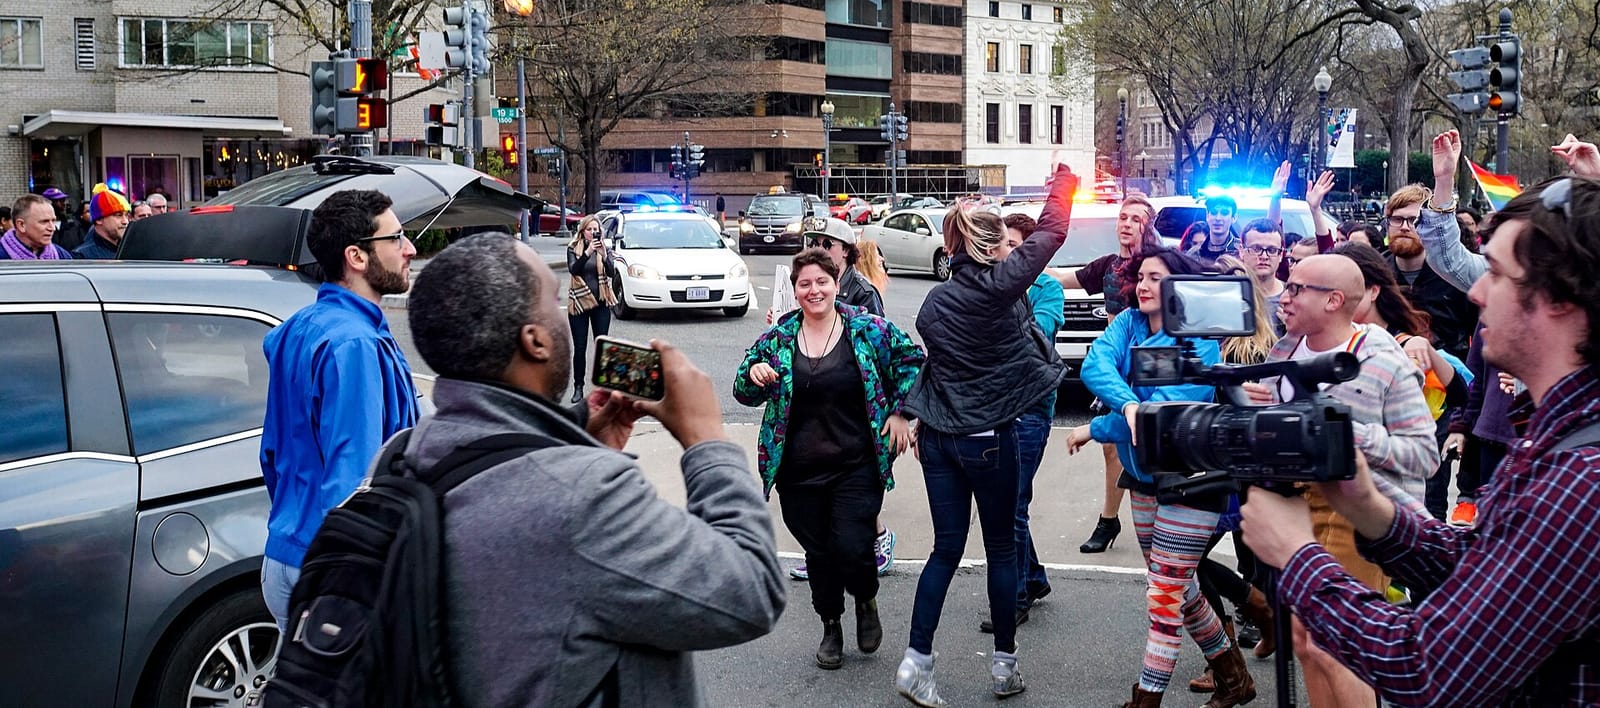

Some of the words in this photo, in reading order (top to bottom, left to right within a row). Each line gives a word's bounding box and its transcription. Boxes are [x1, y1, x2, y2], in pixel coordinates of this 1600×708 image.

[358, 104, 370, 127] 3
[497, 108, 506, 117] 19
[510, 152, 516, 163] 3
